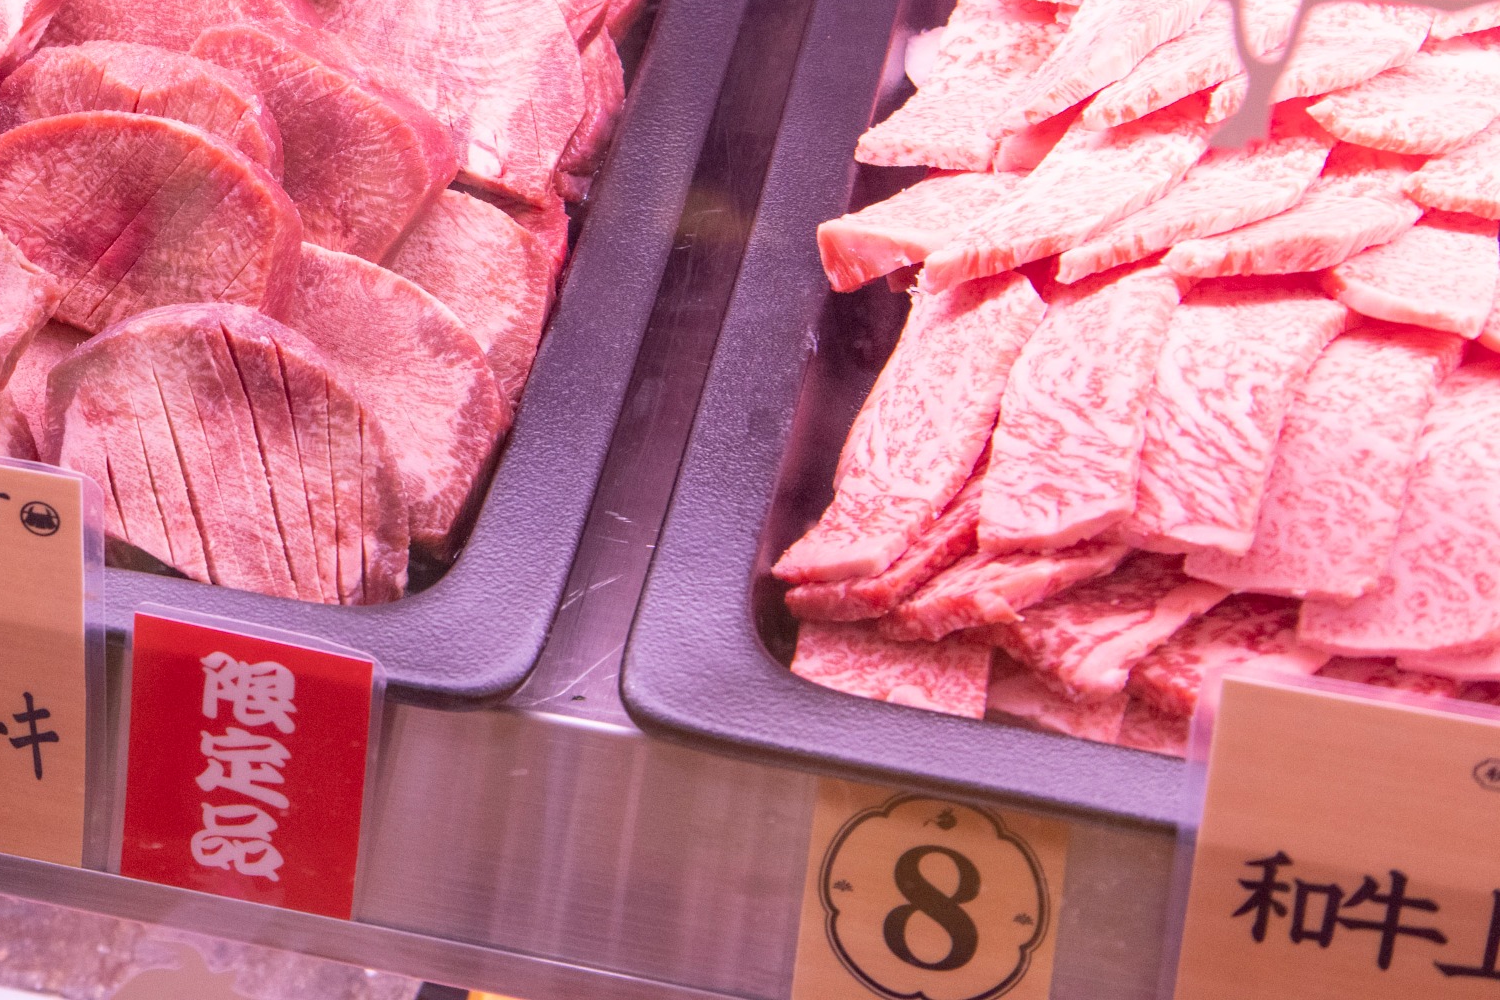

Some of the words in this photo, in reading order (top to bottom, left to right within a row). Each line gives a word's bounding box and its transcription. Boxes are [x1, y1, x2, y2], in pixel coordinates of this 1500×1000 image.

[191, 651, 297, 882] 限定品
[883, 845, 981, 971] 8
